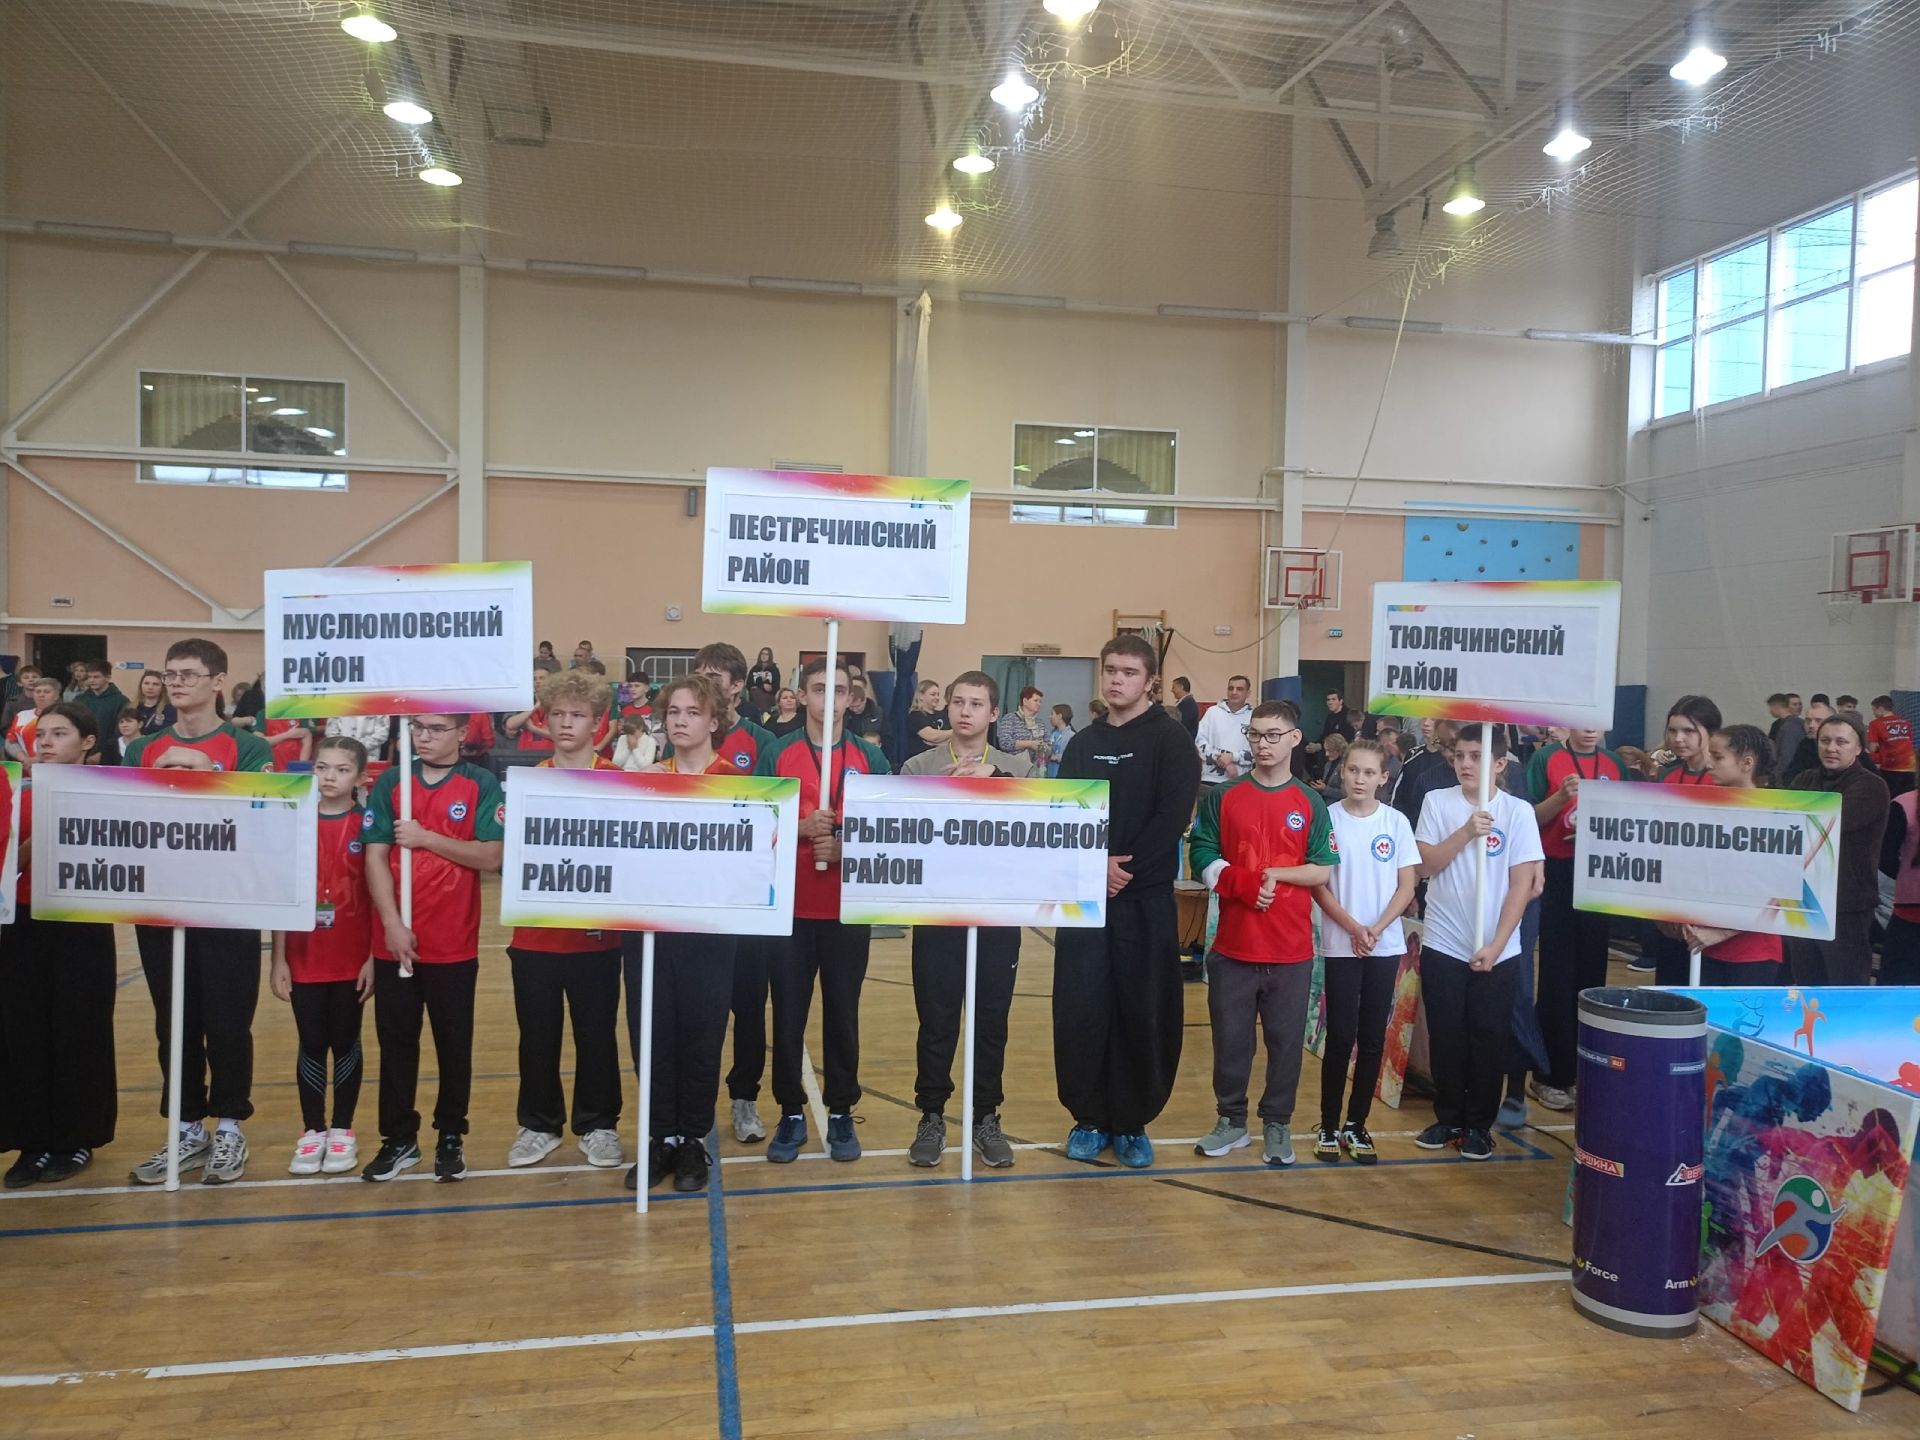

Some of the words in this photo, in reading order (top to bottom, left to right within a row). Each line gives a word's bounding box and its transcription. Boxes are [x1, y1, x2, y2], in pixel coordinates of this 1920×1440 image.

[729, 513, 937, 550] ПЕСТРЕЧИНСКИЙ
[728, 552, 810, 586] РАЙОН
[283, 605, 503, 640] МУСЛЮМОВСКИЙ
[1389, 624, 1565, 656] ТЮЛЯЧИНСКИЙ
[283, 651, 365, 684] РАЙОН
[1387, 661, 1458, 692] РАЙОН
[58, 817, 237, 852] КУКМОРСКИЙ
[524, 817, 753, 852] НИЖНЕКАМСКИЙ
[843, 816, 1108, 850] РЫБНО-СЛОБОДСКОЙ
[1588, 816, 1803, 856] ЧИСТОПОЛЬСКИЙ
[58, 859, 145, 893] РАЙОН
[522, 858, 613, 893] РАЙОН
[842, 852, 923, 885] РАЙОН
[1588, 851, 1662, 884] РАЙОН
[1585, 1260, 1619, 1283] Force
[1664, 1278, 1689, 1290] Arm
